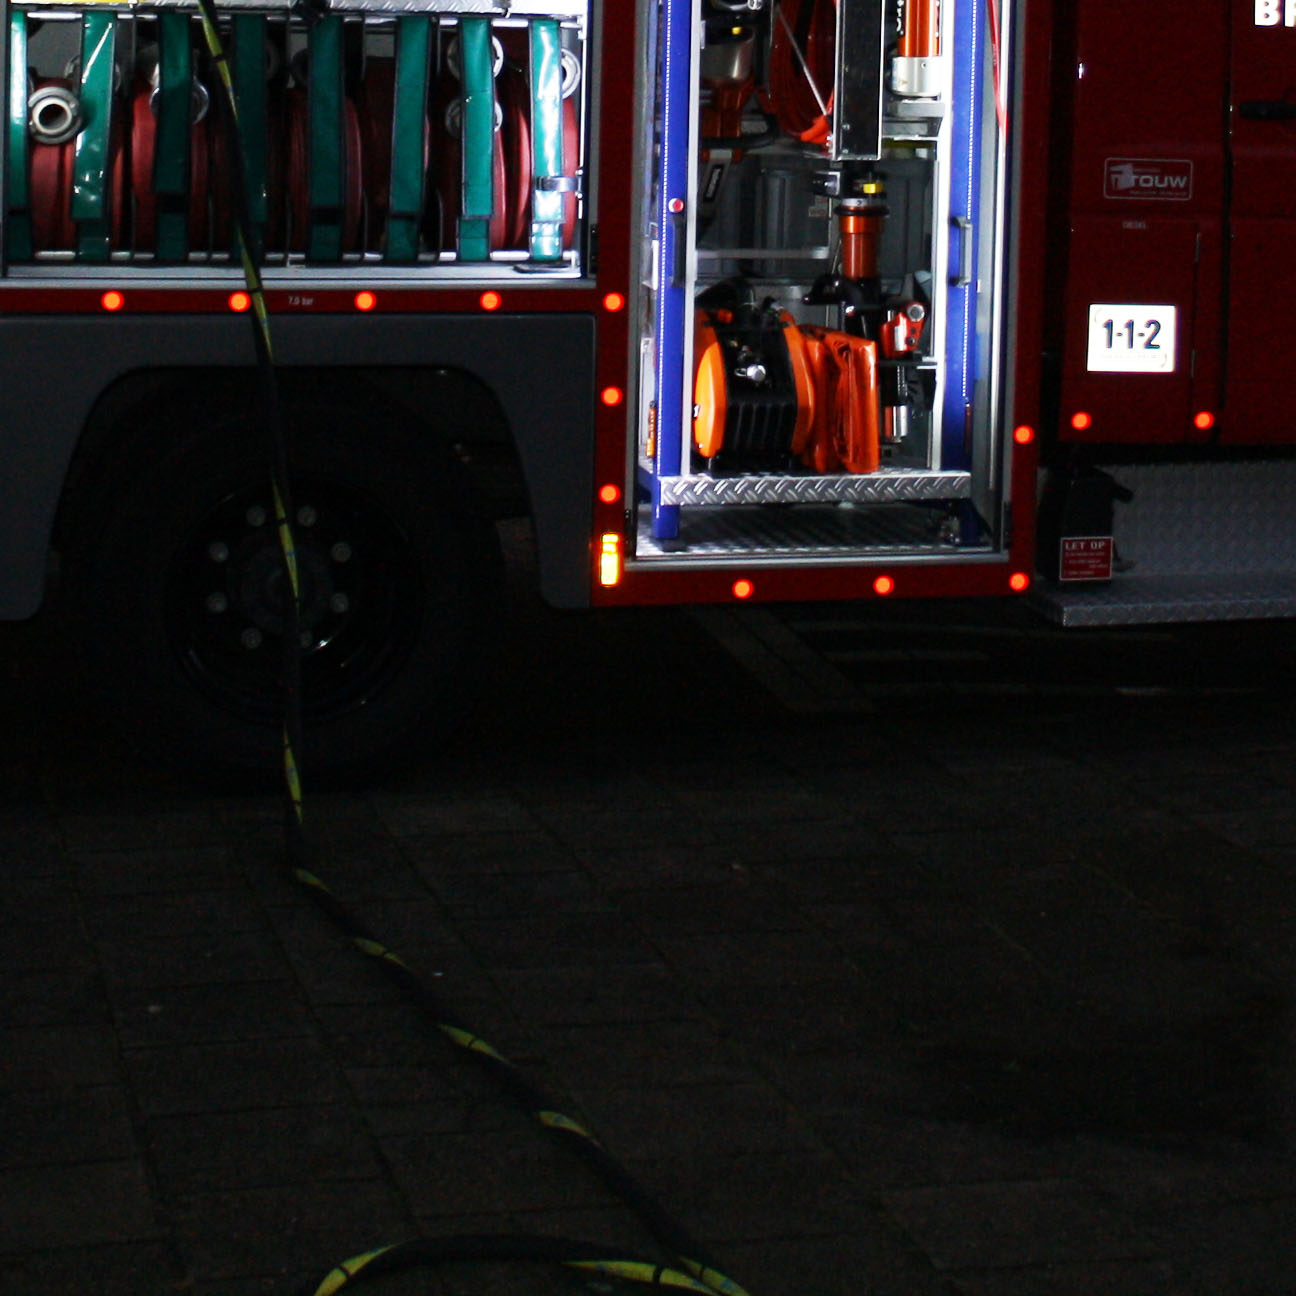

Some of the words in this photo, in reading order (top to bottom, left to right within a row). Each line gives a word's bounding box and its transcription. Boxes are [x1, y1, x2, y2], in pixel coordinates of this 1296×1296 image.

[1102, 319, 1162, 350] 1-1-2
[1065, 541, 1085, 550] LET
[1090, 541, 1106, 550] OP
